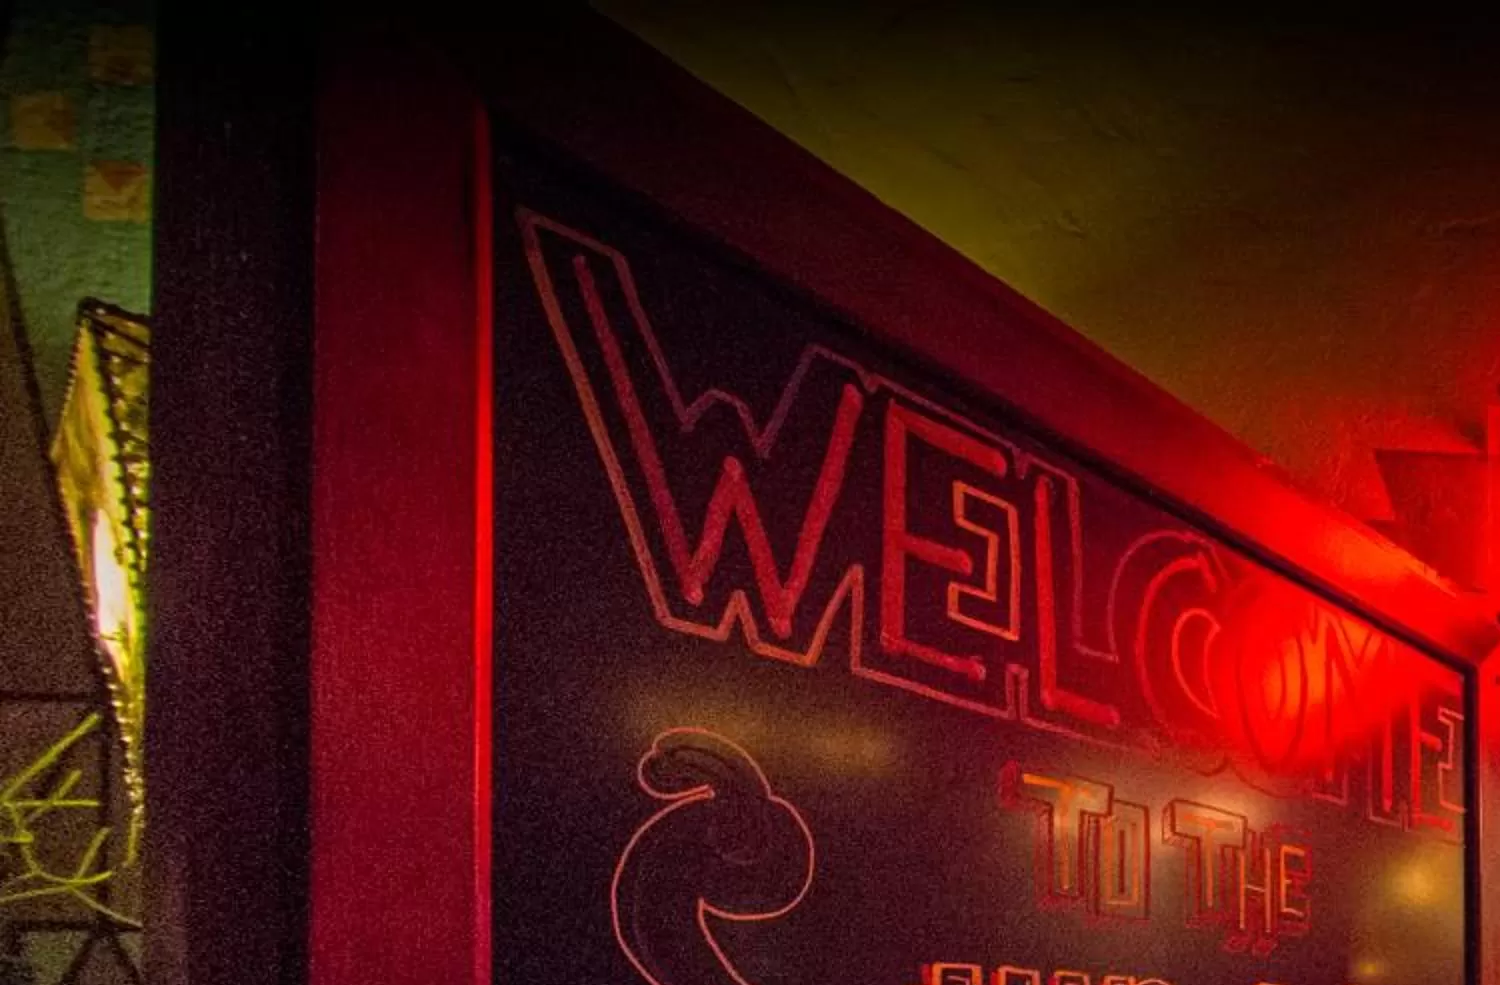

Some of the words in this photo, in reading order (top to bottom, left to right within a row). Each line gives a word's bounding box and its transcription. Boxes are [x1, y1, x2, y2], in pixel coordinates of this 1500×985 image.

[515, 206, 1468, 848] WELCOME
[1002, 762, 1150, 925] TO
[1163, 798, 1312, 950] THE
